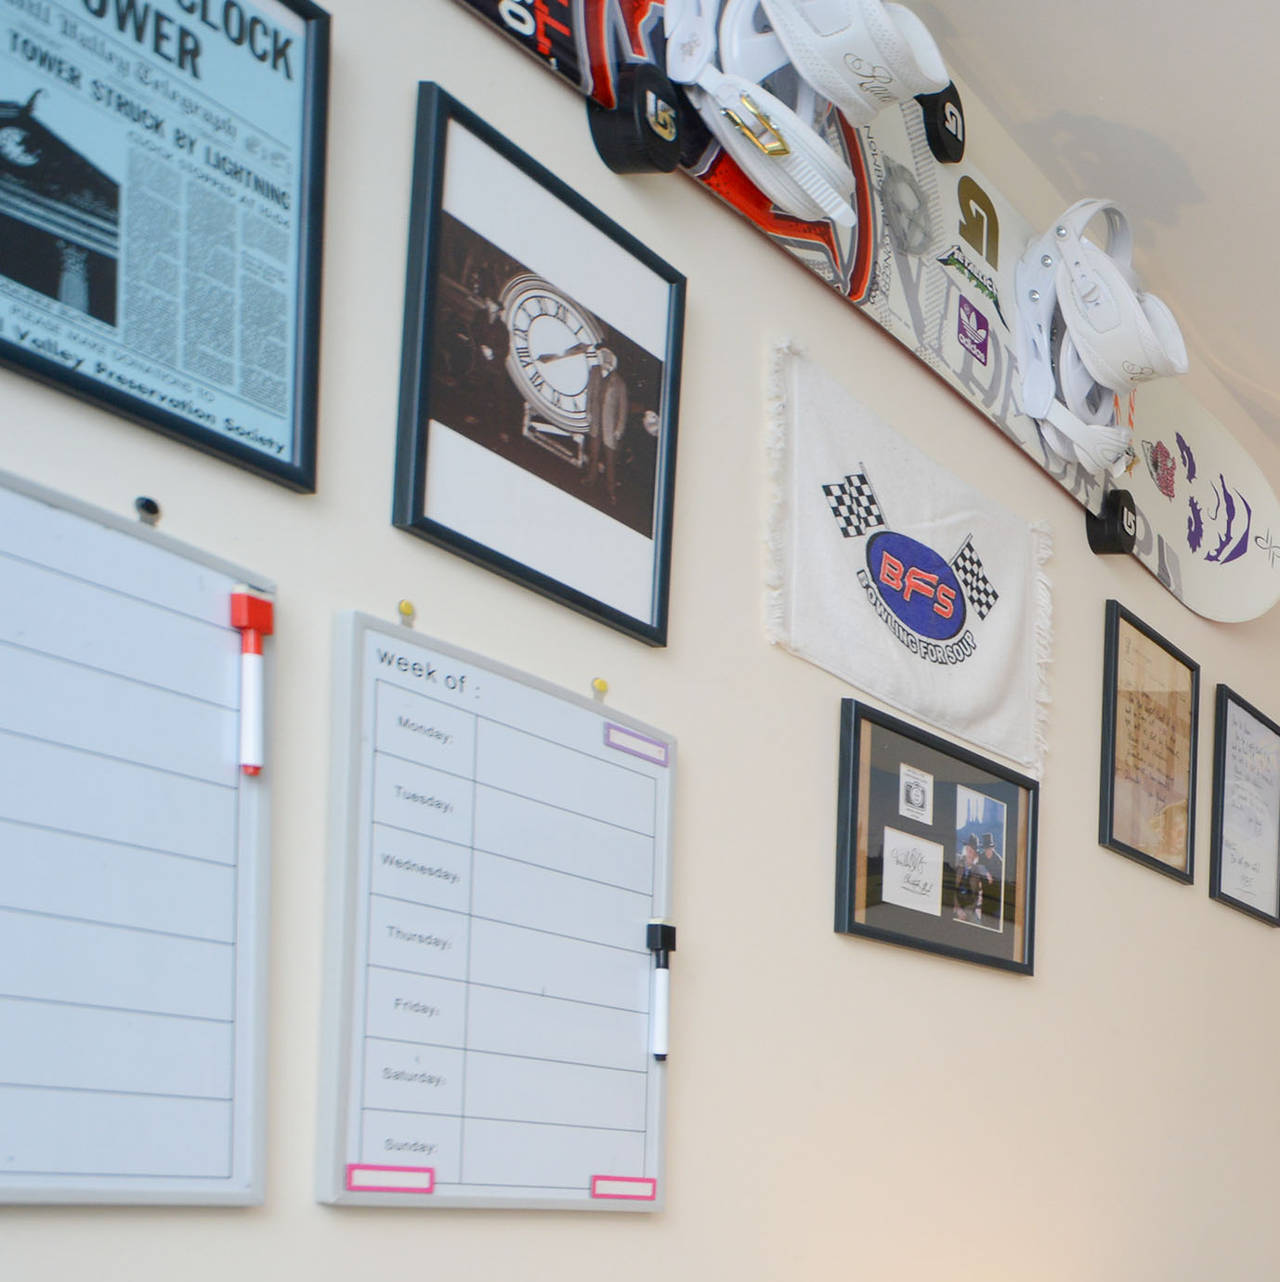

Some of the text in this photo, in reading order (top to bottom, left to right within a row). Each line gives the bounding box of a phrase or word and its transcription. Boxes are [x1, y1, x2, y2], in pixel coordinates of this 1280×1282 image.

[10, 32, 291, 210] TOWER STRUCK BY LIGHTNING
[958, 332, 987, 365] adidas
[16, 325, 285, 455] Valley Preservation Society
[856, 569, 977, 666] BOWLING FOR SOUP
[880, 551, 956, 619] BFS
[376, 645, 438, 683] week
